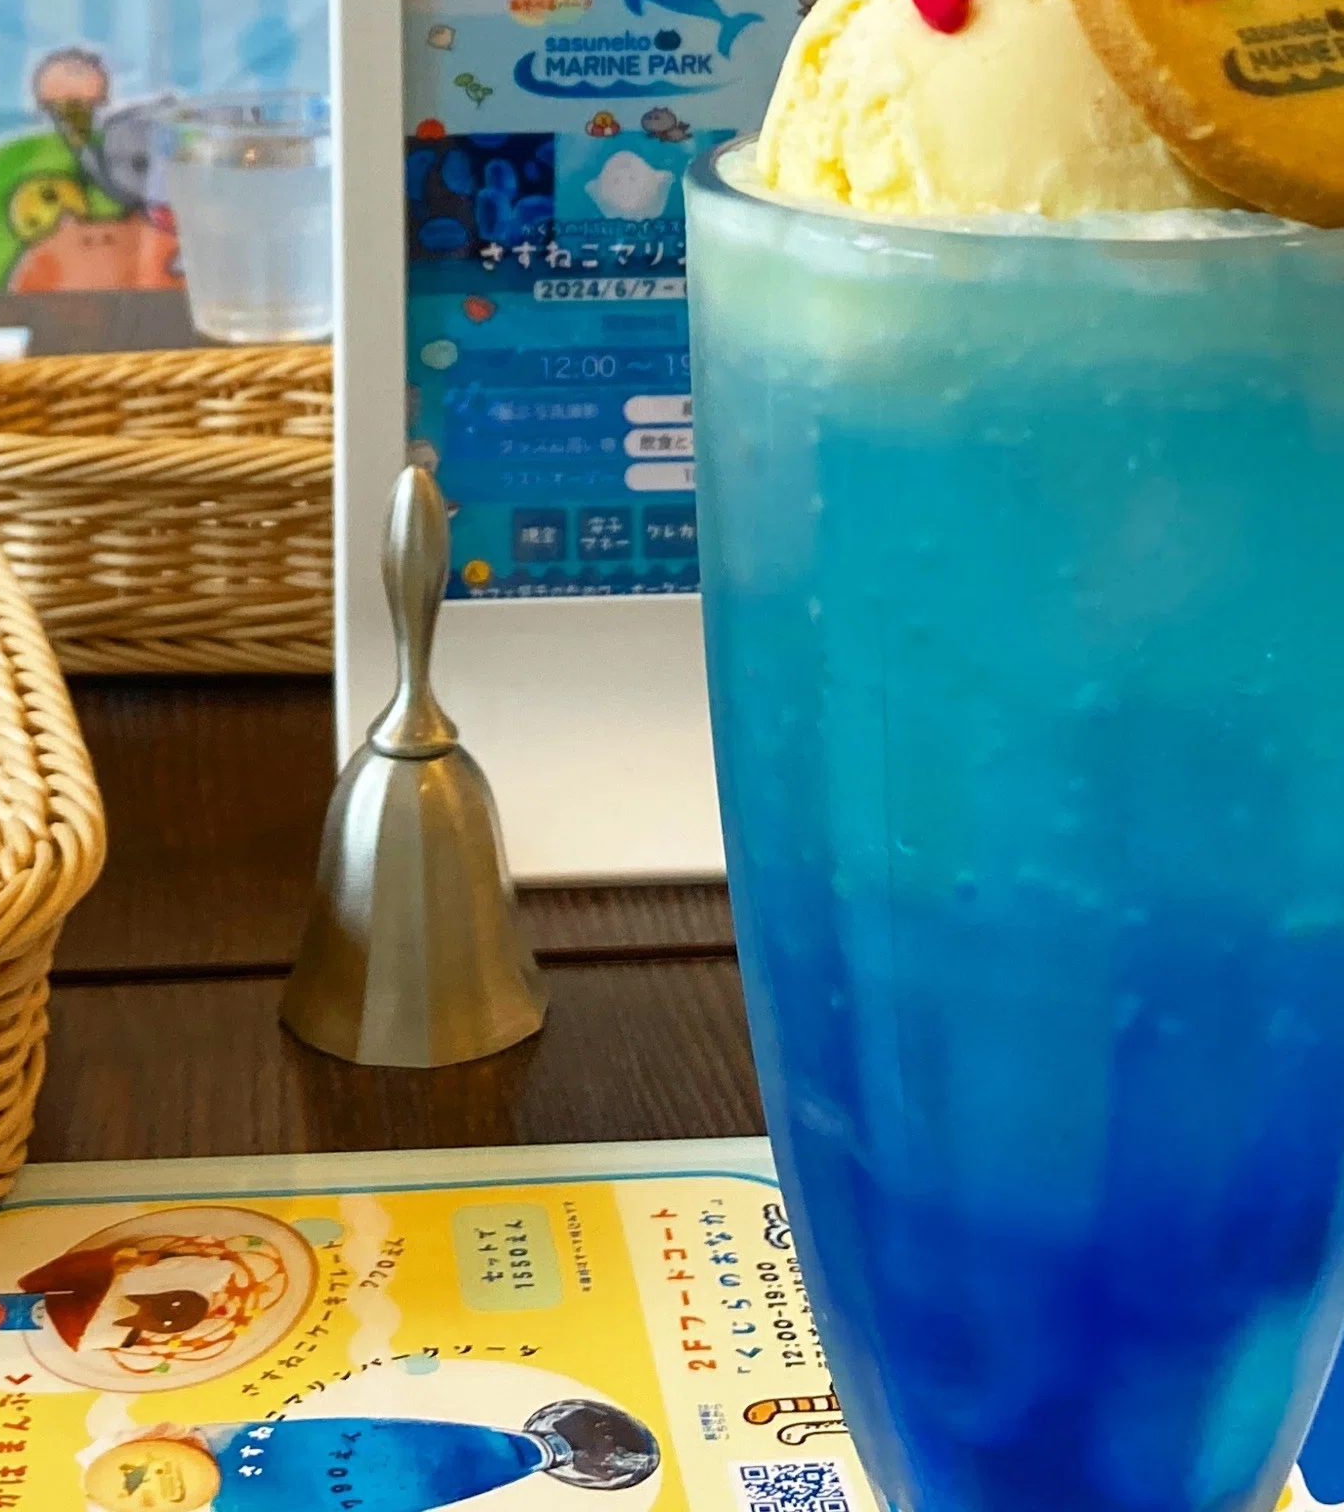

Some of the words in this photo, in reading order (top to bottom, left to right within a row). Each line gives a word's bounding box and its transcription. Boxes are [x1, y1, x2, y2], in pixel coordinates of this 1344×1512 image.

[545, 30, 651, 53] sasuneko
[545, 54, 641, 77] MARINE
[648, 53, 713, 76] PARK
[541, 280, 687, 299] 2024/6/7-
[359, 1237, 406, 1289] 770えん
[475, 1227, 504, 1283] セットで
[504, 1218, 535, 1290] 1550えん
[650, 1207, 718, 1371] 2Fフードコート
[698, 1198, 763, 1374] 「くじらのおなか」
[756, 1261, 806, 1368] 12:00-19:00
